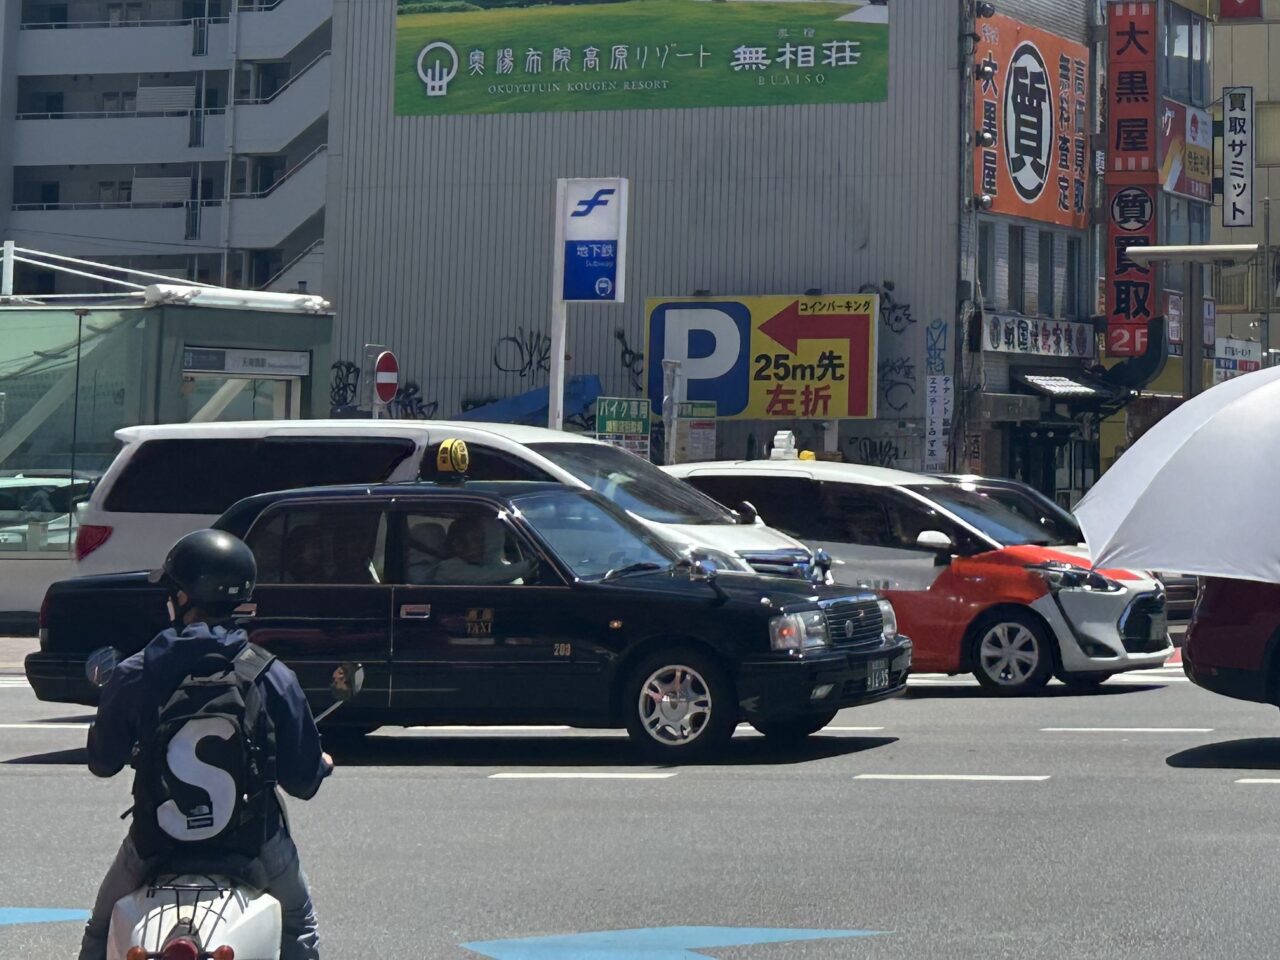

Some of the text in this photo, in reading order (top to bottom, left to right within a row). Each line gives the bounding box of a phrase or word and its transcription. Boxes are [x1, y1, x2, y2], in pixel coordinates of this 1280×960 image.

[730, 40, 862, 70] 無相荘
[488, 79, 670, 94] OKUYUFUIN KOUGEN RESORT
[1115, 21, 1150, 152] 大黒屋
[980, 49, 999, 198] 大黒屋
[1010, 65, 1048, 185] 質
[1228, 93, 1248, 222] 買取サミット
[1116, 190, 1149, 226] 質
[577, 243, 614, 257] 地下鉄
[1113, 236, 1151, 321] 買取
[800, 300, 871, 313] コインパーキング
[663, 308, 742, 402] P
[753, 351, 846, 382] 25m先
[765, 383, 832, 417] 左折
[466, 622, 492, 633] TAXI
[156, 717, 237, 841] S
